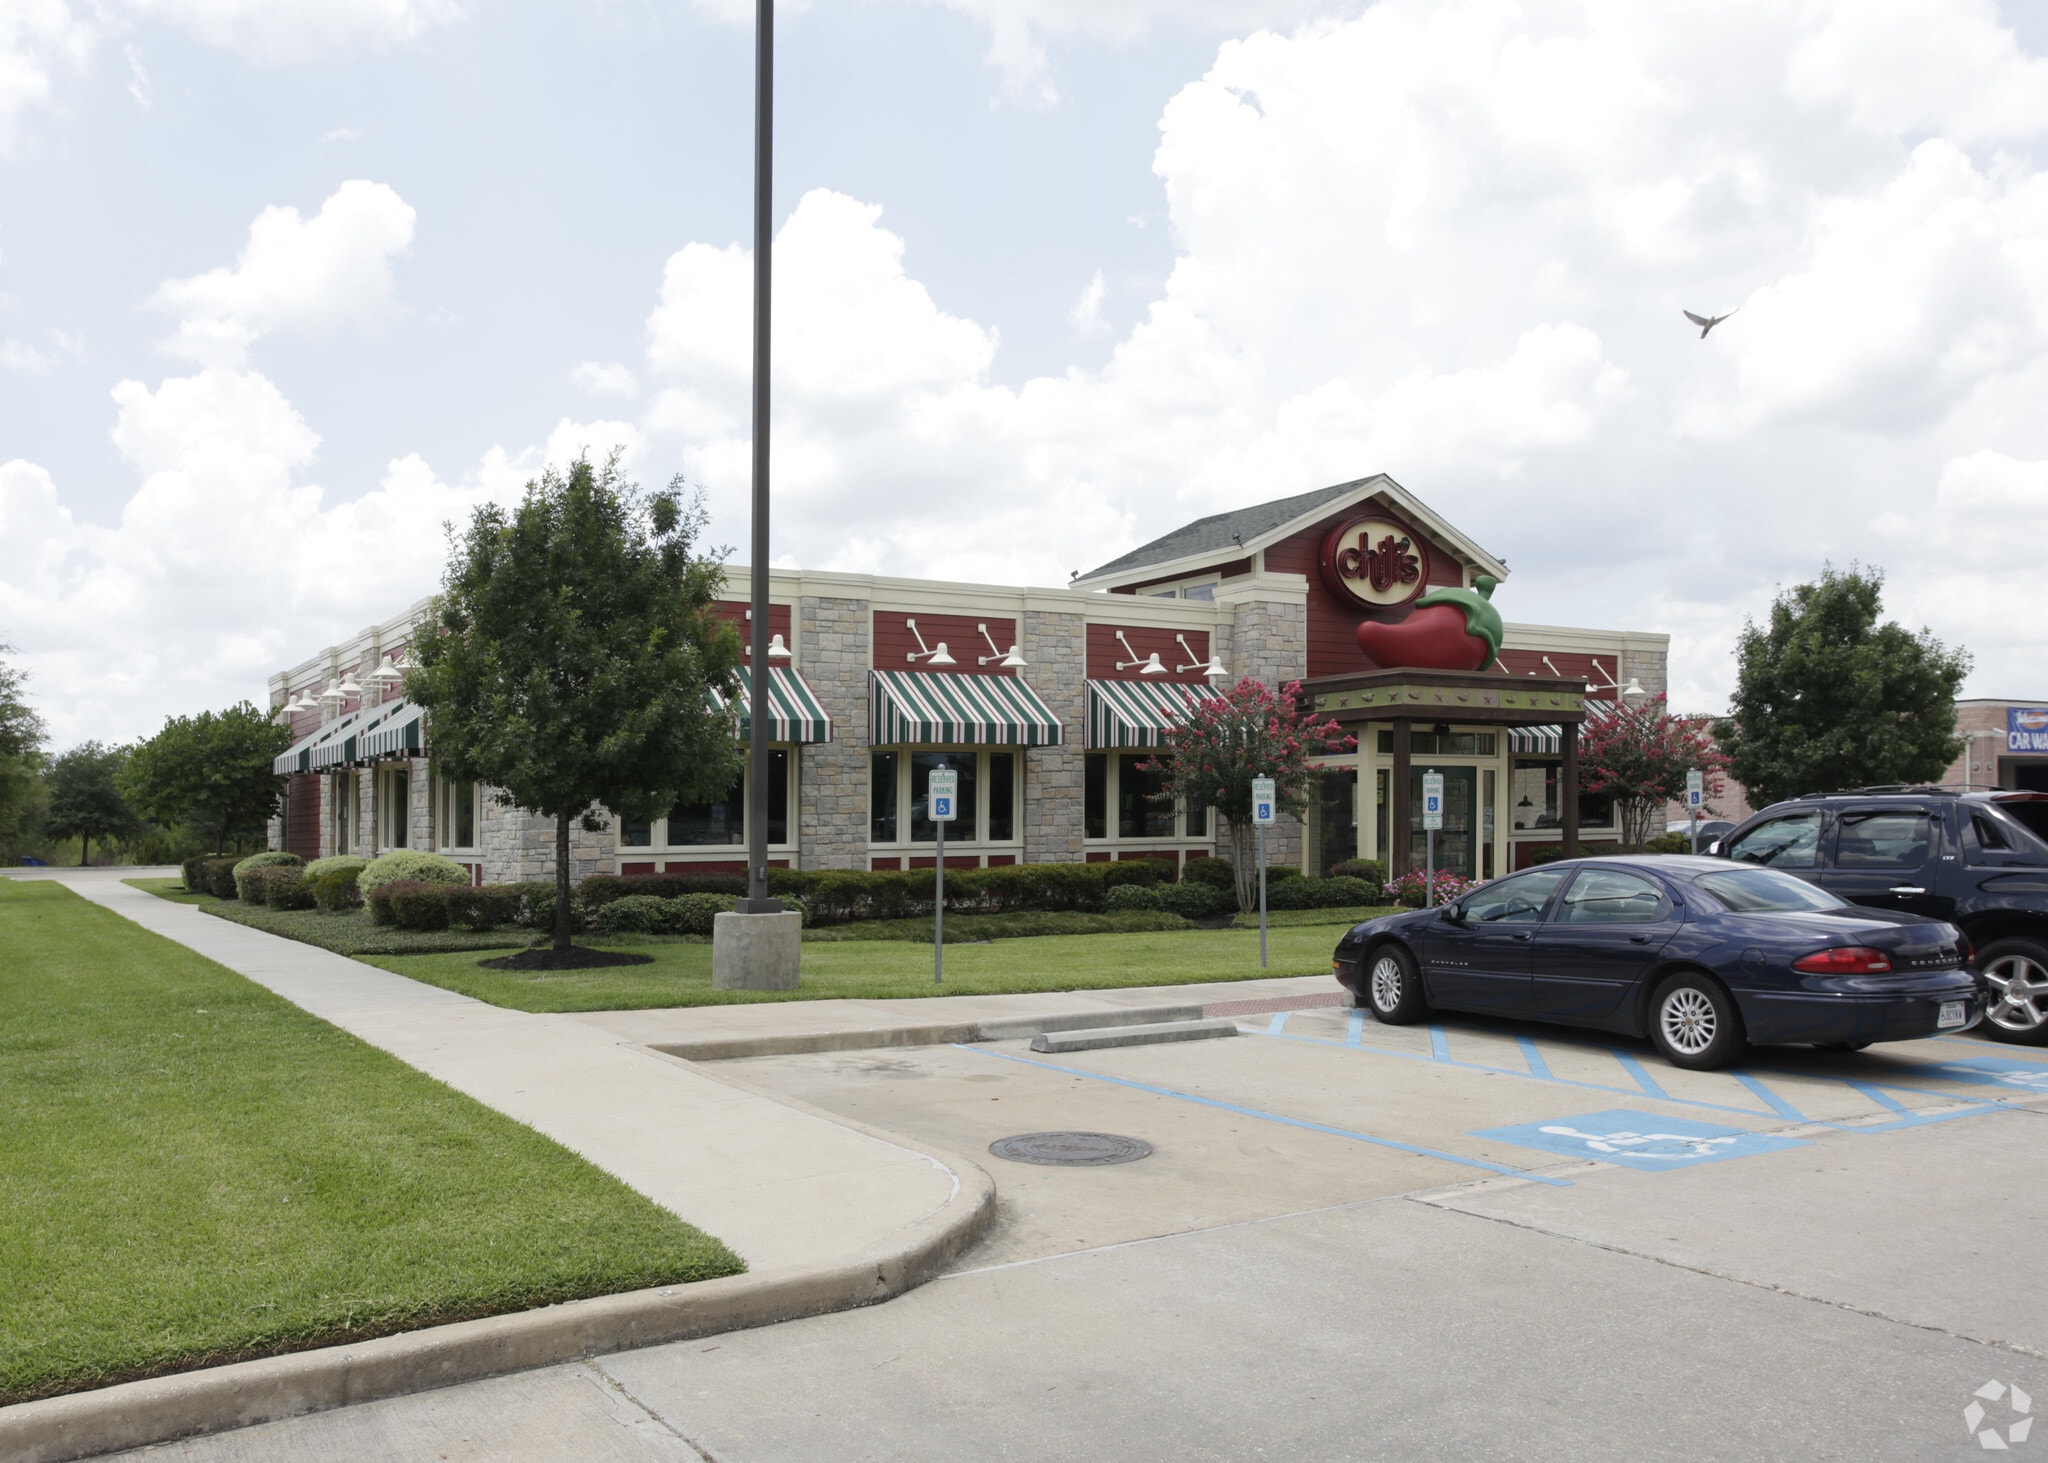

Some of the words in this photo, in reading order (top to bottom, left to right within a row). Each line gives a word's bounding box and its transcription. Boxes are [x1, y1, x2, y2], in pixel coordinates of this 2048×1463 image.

[2009, 731, 2031, 750] CAR
[931, 775, 955, 784] RESERVED
[933, 786, 953, 795] PARKING
[1253, 783, 1274, 791] RESERVED
